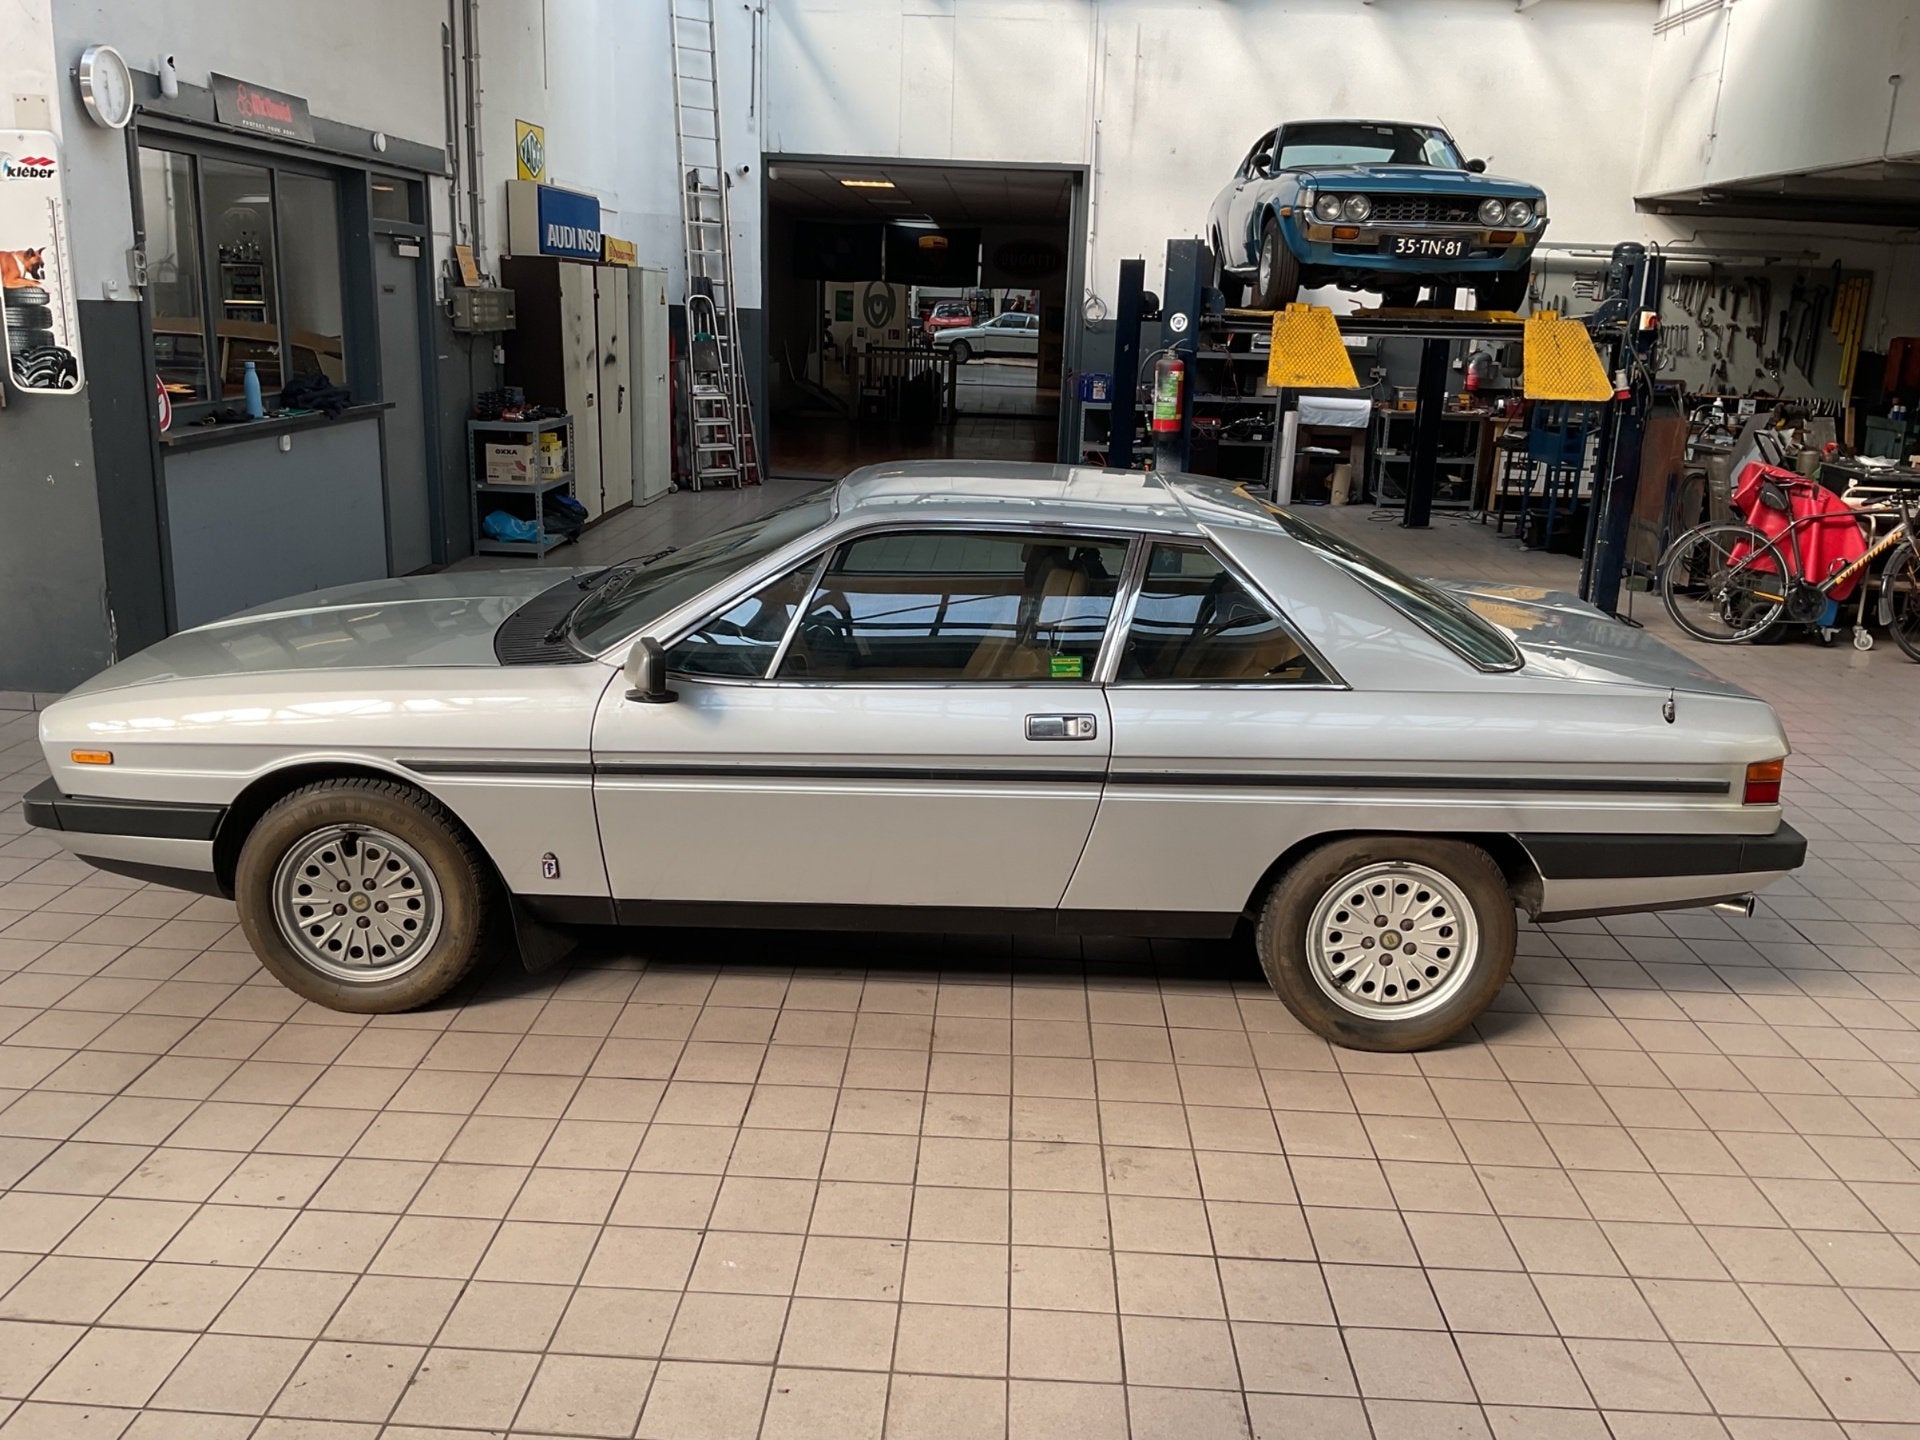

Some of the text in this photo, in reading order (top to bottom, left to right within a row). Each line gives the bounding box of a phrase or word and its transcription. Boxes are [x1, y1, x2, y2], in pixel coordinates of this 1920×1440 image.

[546, 223, 601, 253] AUDI NSU
[1395, 238, 1462, 256] 35-TN-81
